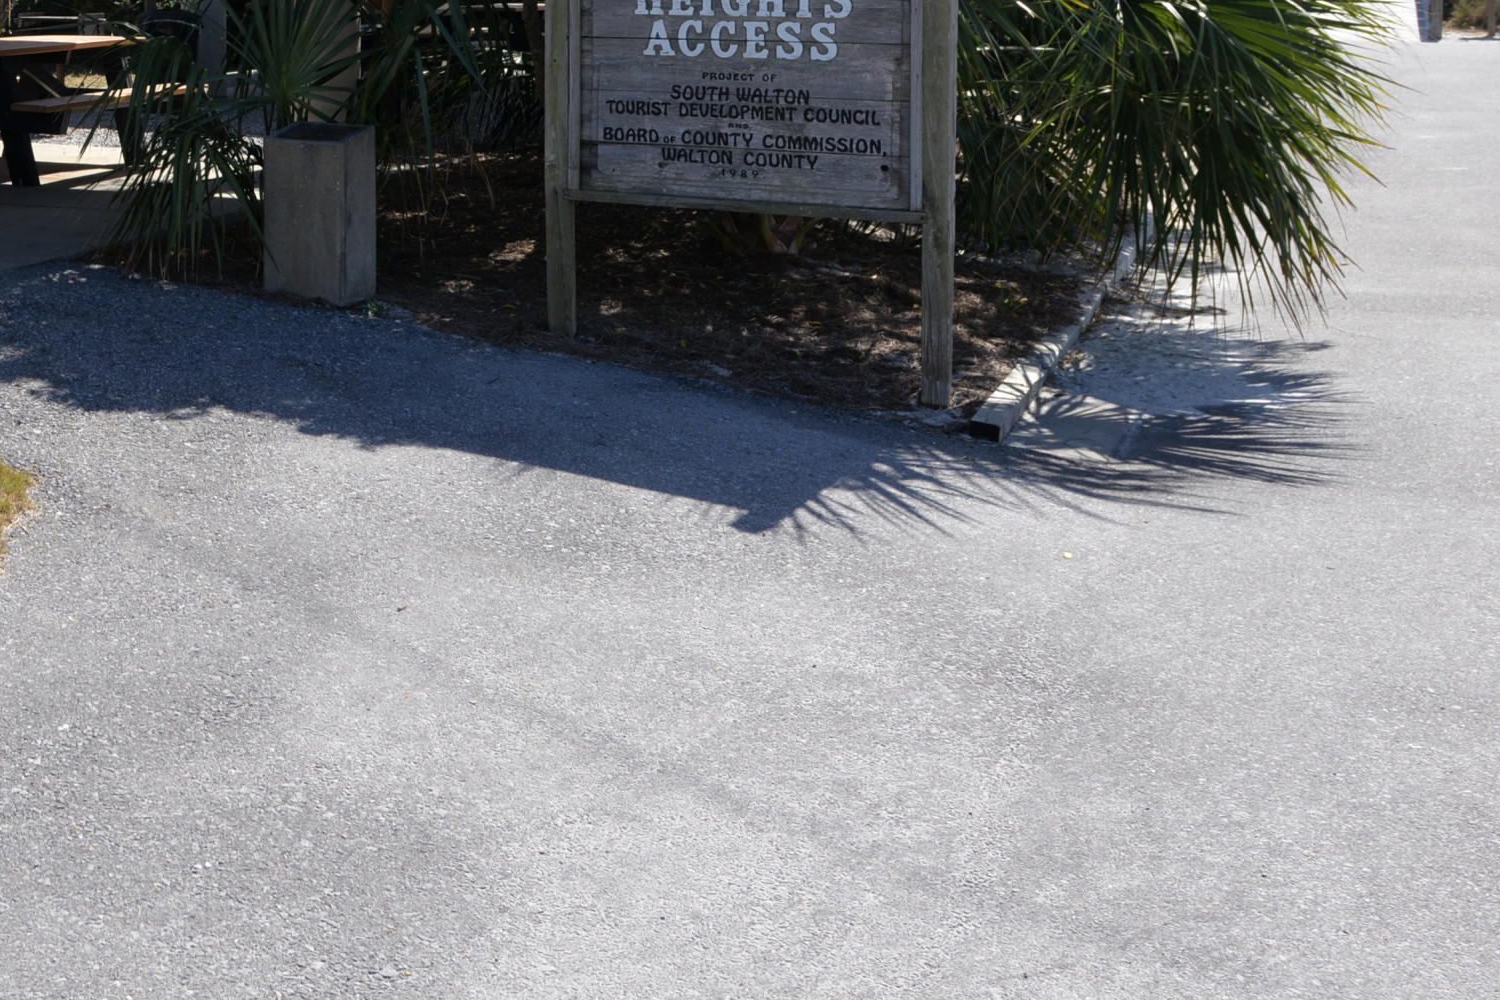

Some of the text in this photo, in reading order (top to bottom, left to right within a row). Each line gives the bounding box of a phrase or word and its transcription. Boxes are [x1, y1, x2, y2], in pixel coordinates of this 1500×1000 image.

[643, 18, 838, 61] ACCESS
[702, 71, 777, 82] PROJECT OF
[670, 84, 810, 105] SOUTH WALTON
[606, 100, 881, 126] TOURIST DEVELOPMENT COUNCIL
[728, 122, 749, 130] AND
[603, 126, 887, 158] BOARD OF COUNTY COMMISSION,
[662, 147, 818, 170] WALTON COUNTY
[721, 168, 759, 179] 1989
